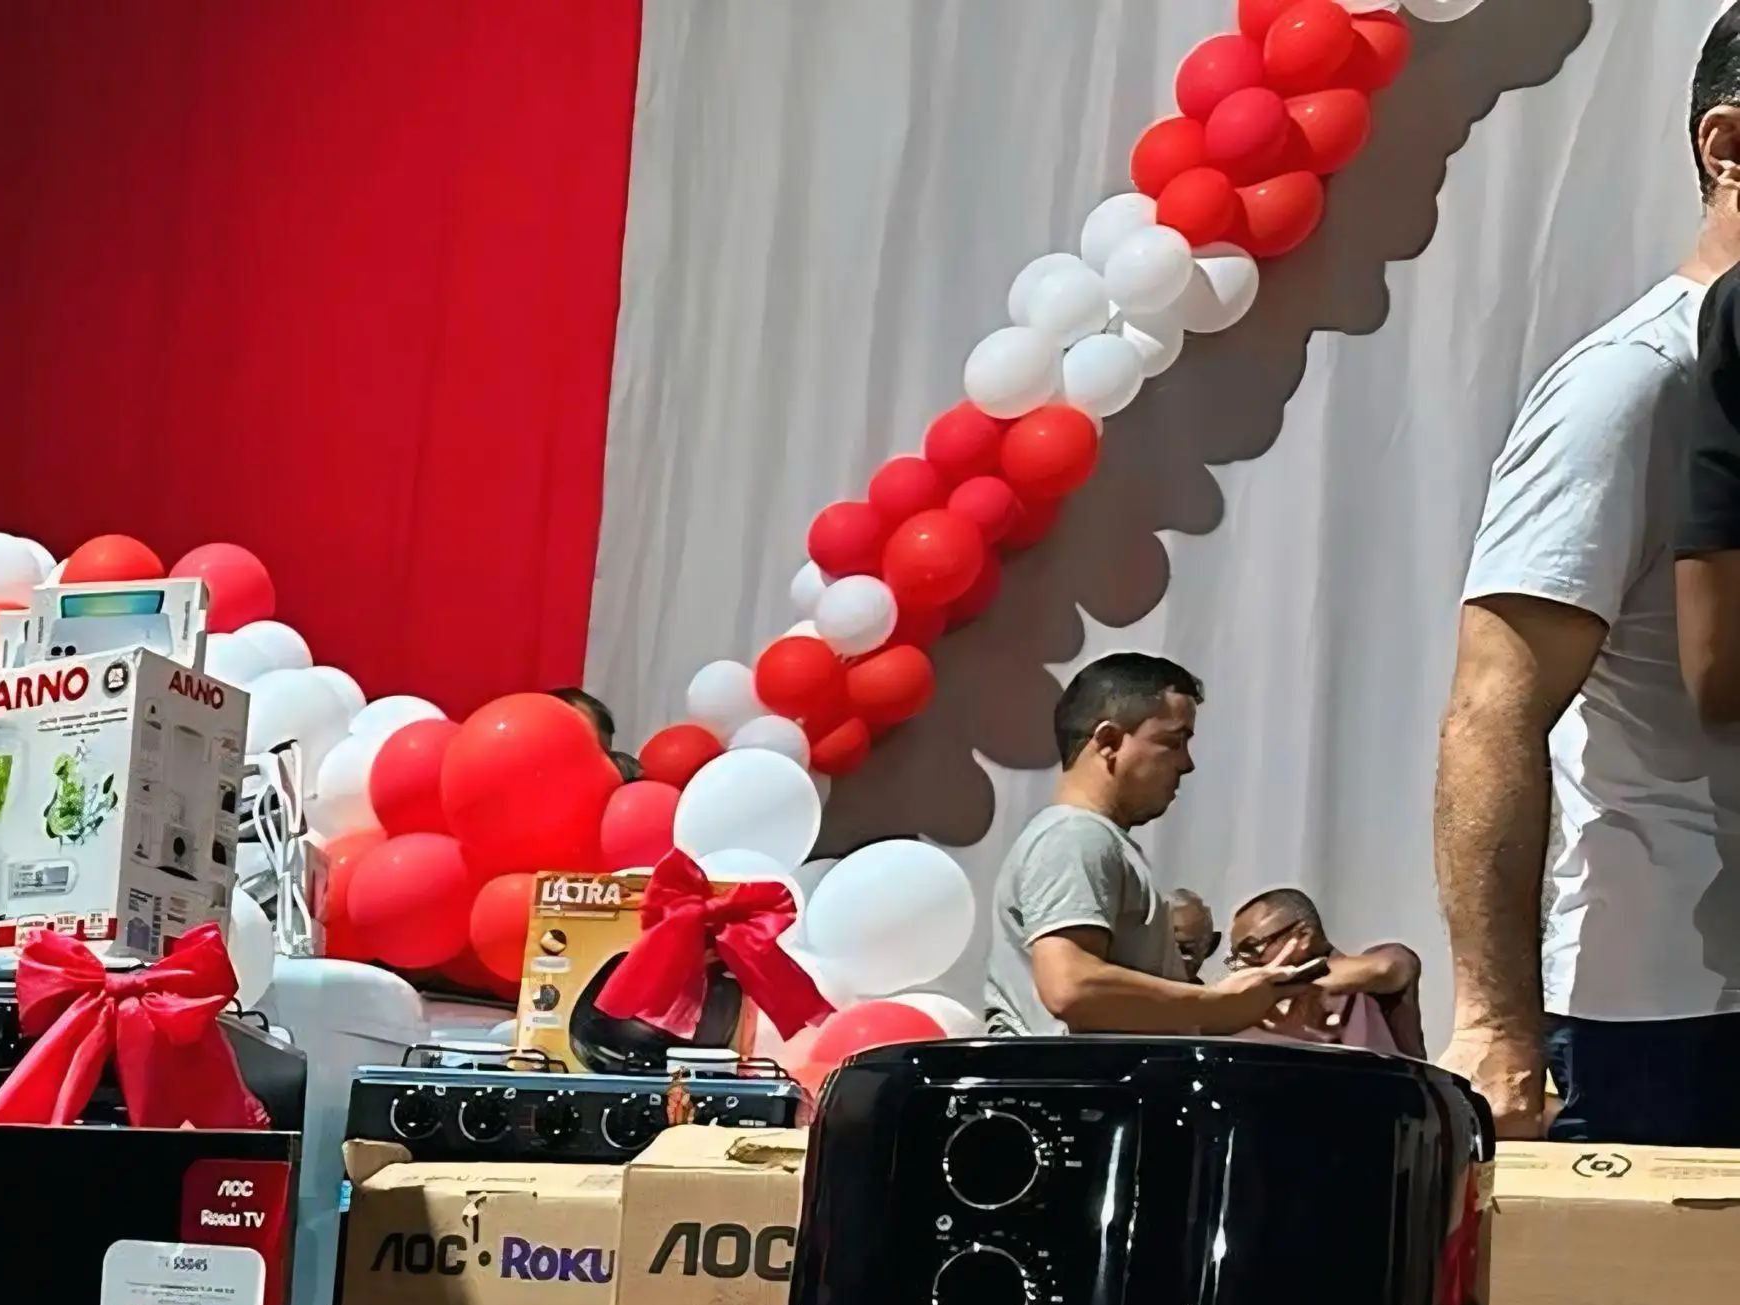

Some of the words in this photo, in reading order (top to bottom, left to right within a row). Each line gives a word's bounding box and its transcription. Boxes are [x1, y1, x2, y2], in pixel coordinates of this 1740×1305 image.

[168, 670, 224, 709] ARNO
[541, 879, 622, 906] ULTRA
[217, 1180, 255, 1197] AOC
[243, 1211, 266, 1229] TV
[370, 1232, 467, 1275] AOC
[648, 1221, 798, 1282] AOC
